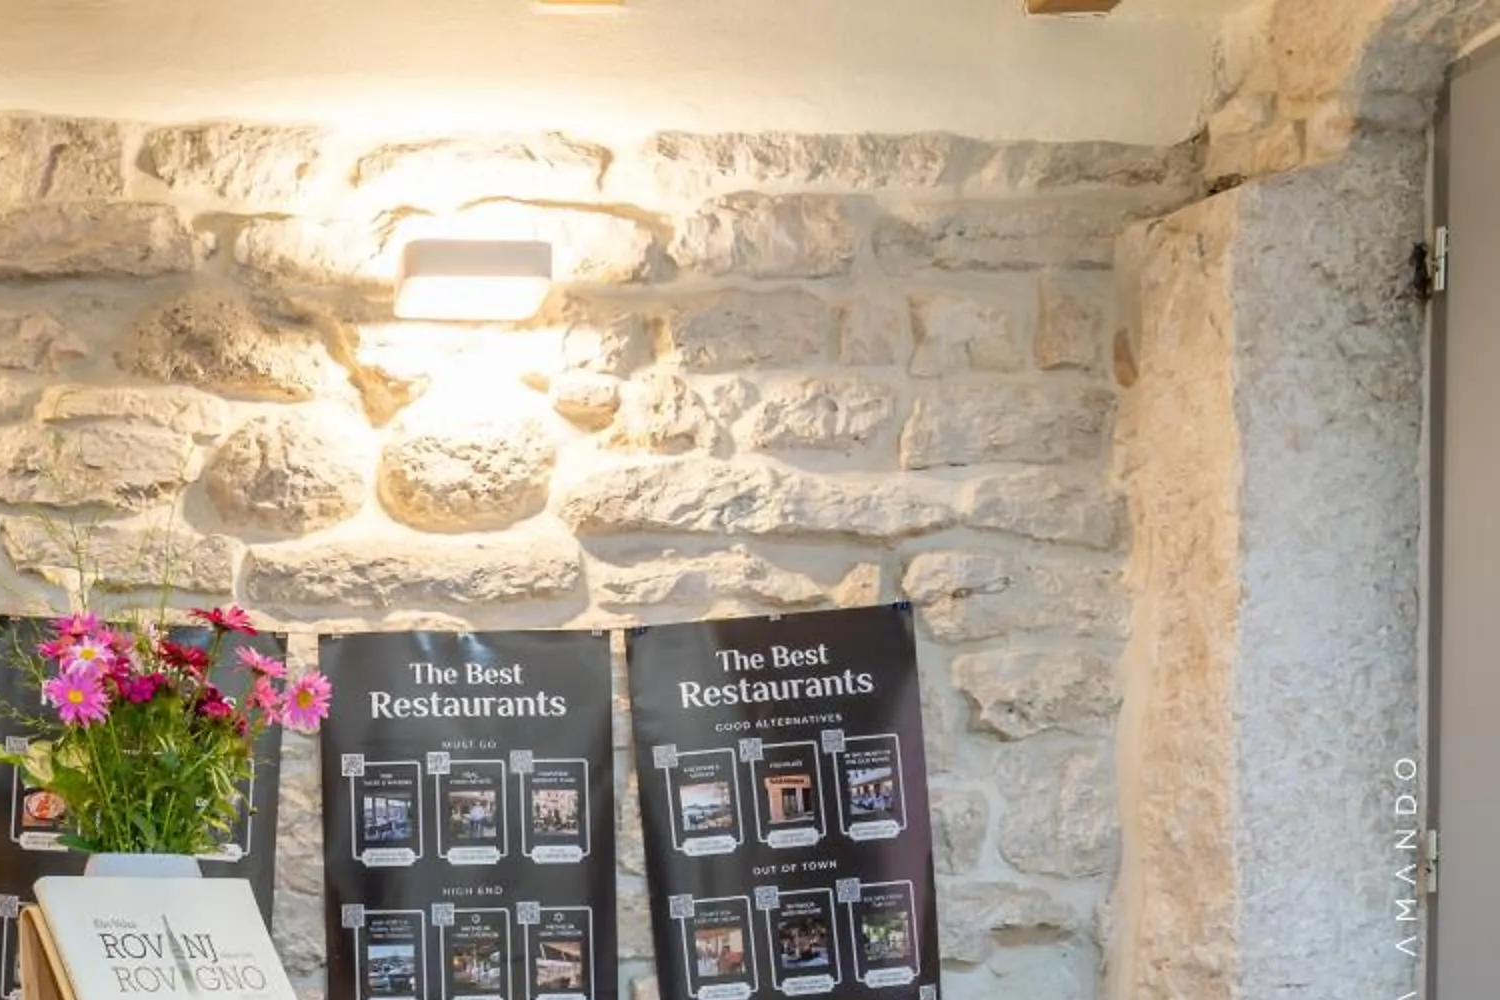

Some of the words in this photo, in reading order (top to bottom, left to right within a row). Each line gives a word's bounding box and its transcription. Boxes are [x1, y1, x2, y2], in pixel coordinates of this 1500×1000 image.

[715, 649, 765, 673] The
[771, 643, 830, 669] Best
[409, 663, 459, 685] The
[465, 663, 524, 685] Best
[678, 668, 876, 709] Restaurants
[368, 690, 568, 719] Restaurants
[715, 720, 751, 733] GOOD
[755, 713, 844, 729] ALTERNATIVES
[442, 739, 476, 750] MUST
[479, 739, 498, 750] GO
[752, 864, 777, 876] OUT
[781, 863, 797, 874] OF
[802, 859, 838, 871] TOWN
[442, 885, 474, 896] HIGH
[477, 885, 504, 896] END
